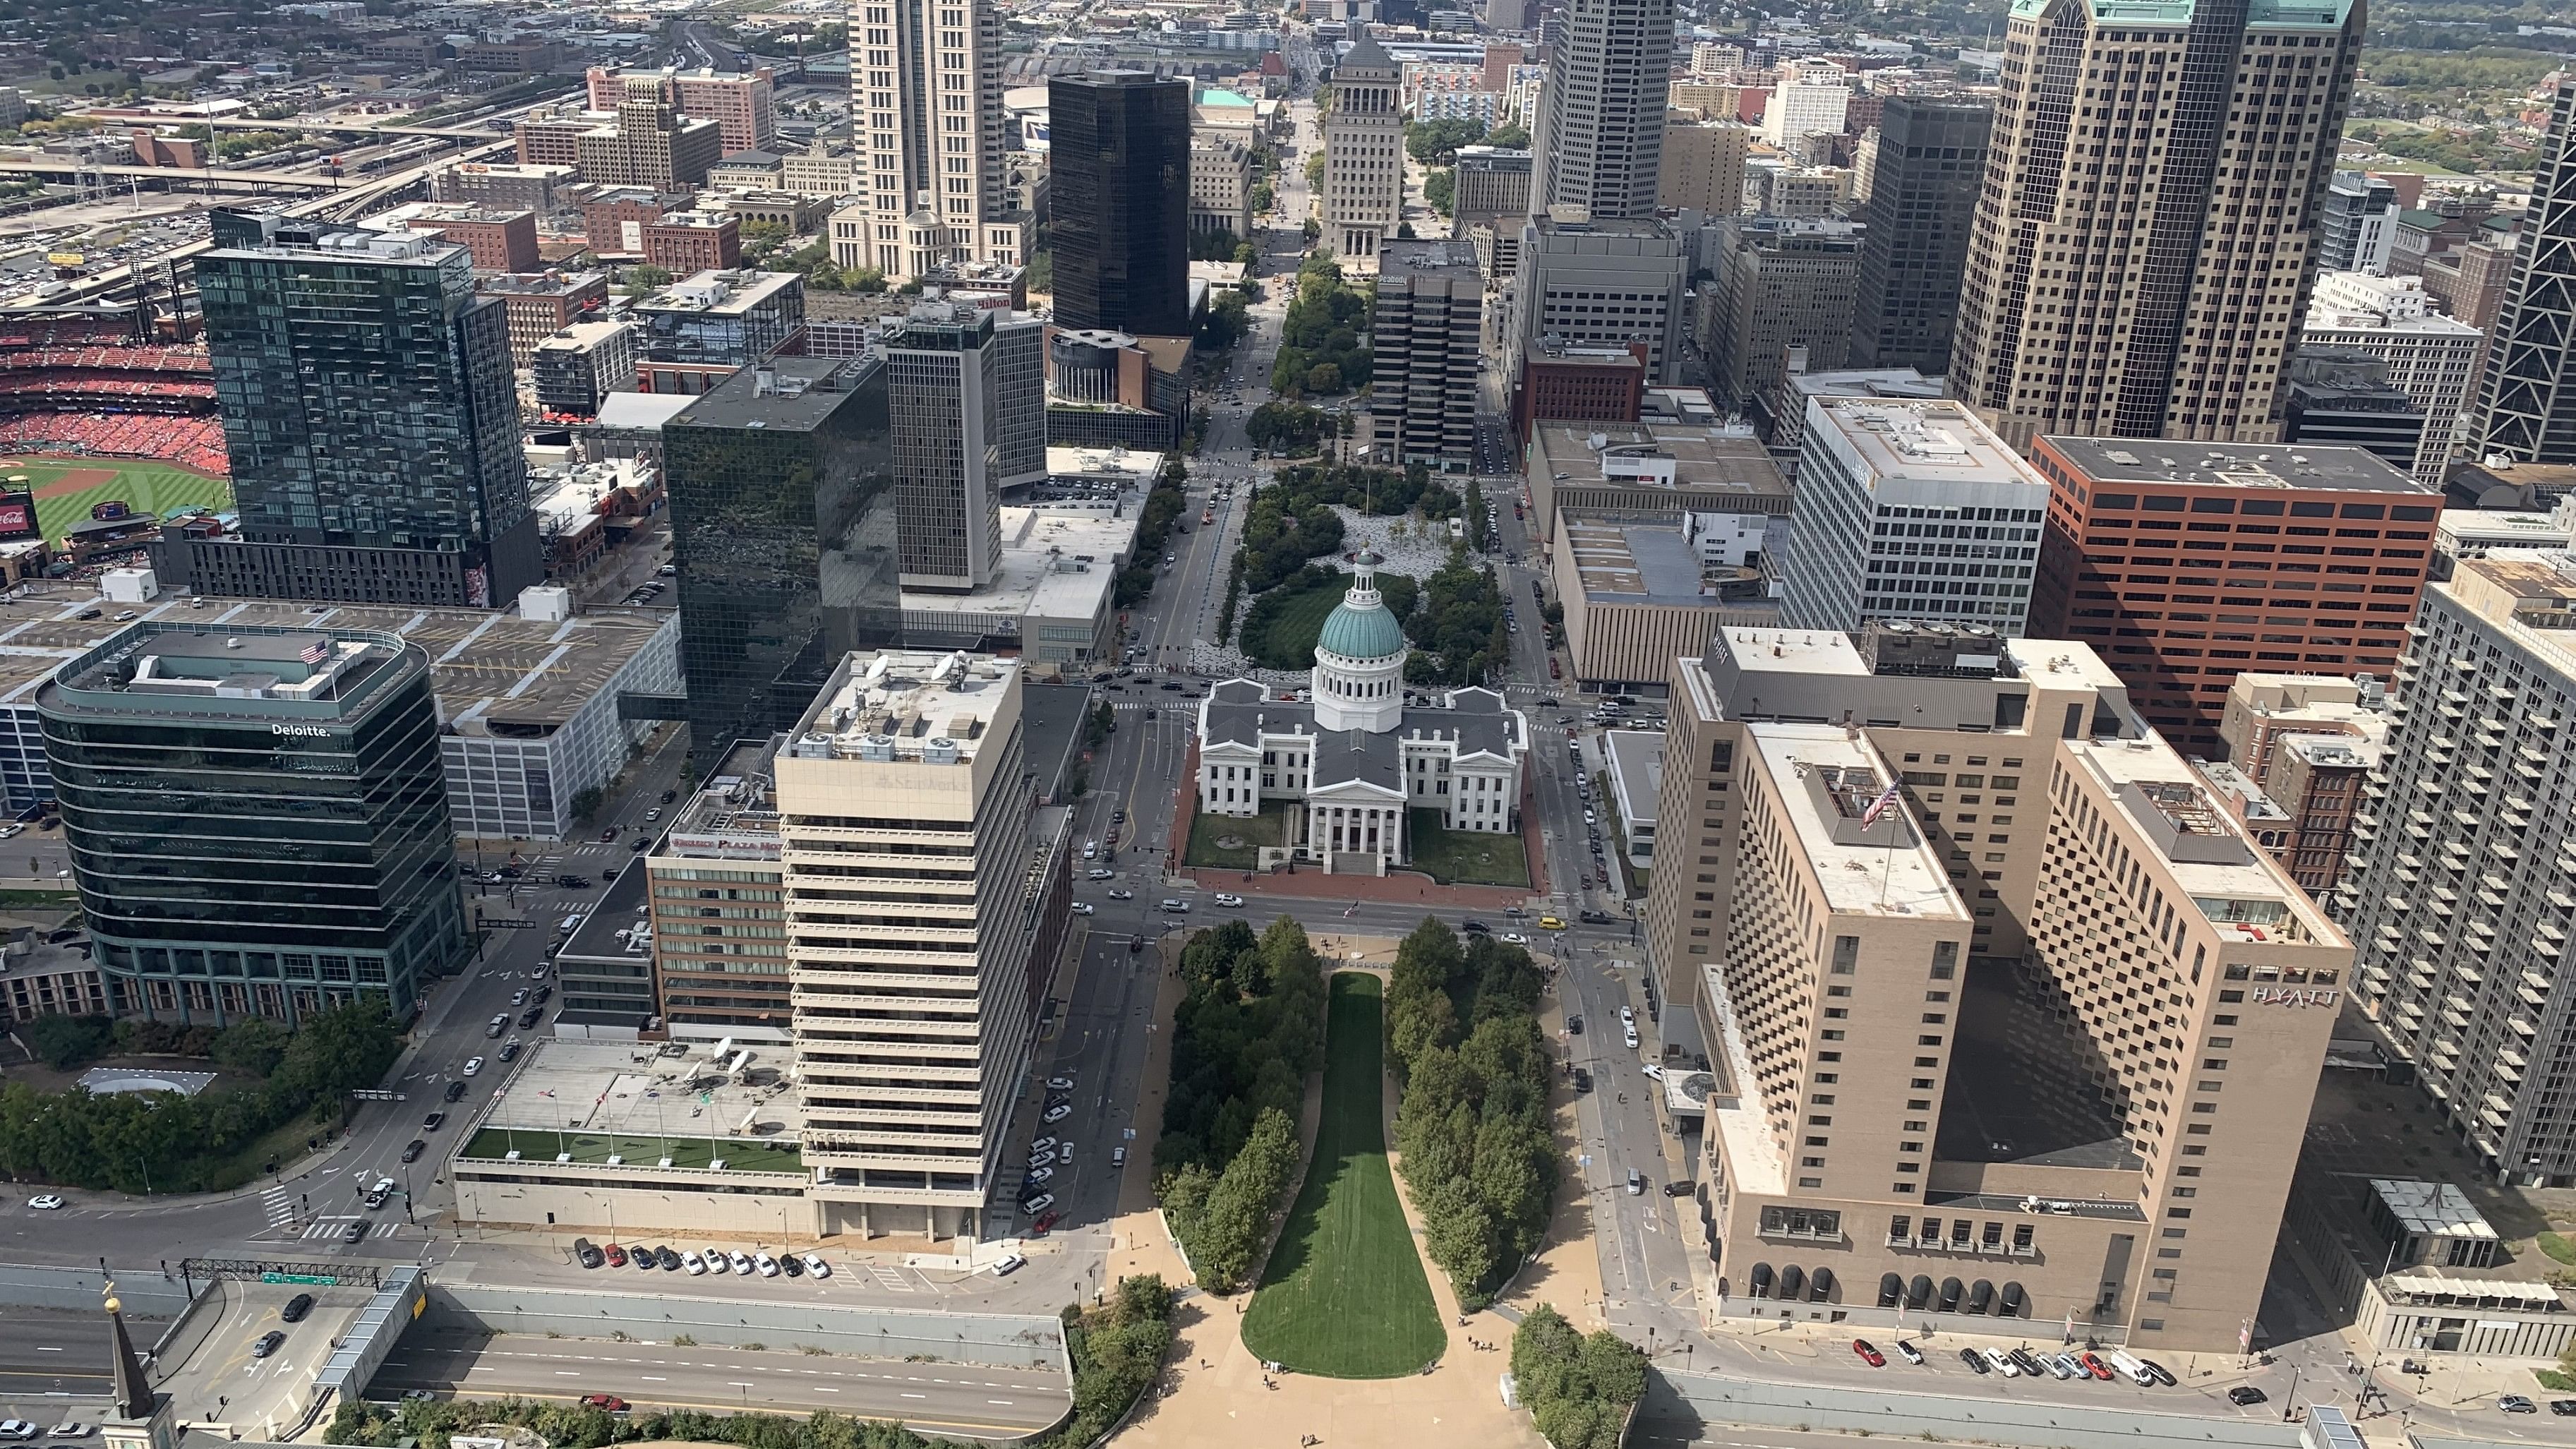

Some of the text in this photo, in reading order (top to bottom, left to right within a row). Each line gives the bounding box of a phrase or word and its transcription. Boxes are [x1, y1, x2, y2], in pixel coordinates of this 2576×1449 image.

[1379, 275, 1407, 286] Peabody
[977, 298, 1010, 309] Hilton
[1713, 633, 1728, 666] HYATT
[717, 840, 757, 850] PLAZA
[2252, 987, 2339, 1007] HYATT
